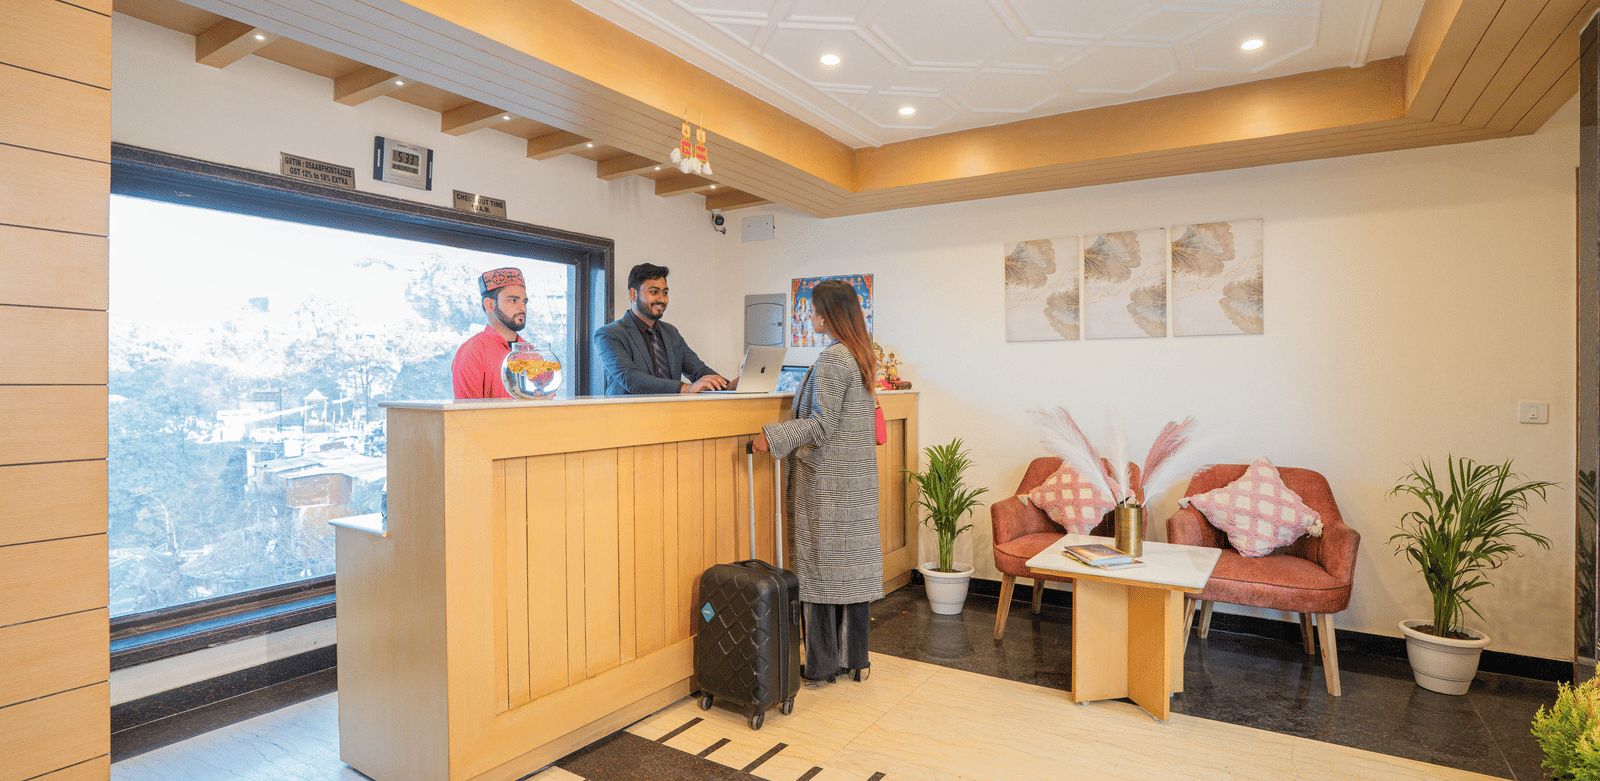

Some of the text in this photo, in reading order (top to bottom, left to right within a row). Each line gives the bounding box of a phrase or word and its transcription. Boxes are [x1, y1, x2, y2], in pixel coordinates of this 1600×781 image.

[284, 156, 301, 167] GSTIN
[289, 166, 301, 175] GST
[302, 169, 313, 178] 12%
[331, 176, 349, 185] EXTRA
[456, 193, 477, 203] CHEC
[490, 200, 504, 208] TIME
